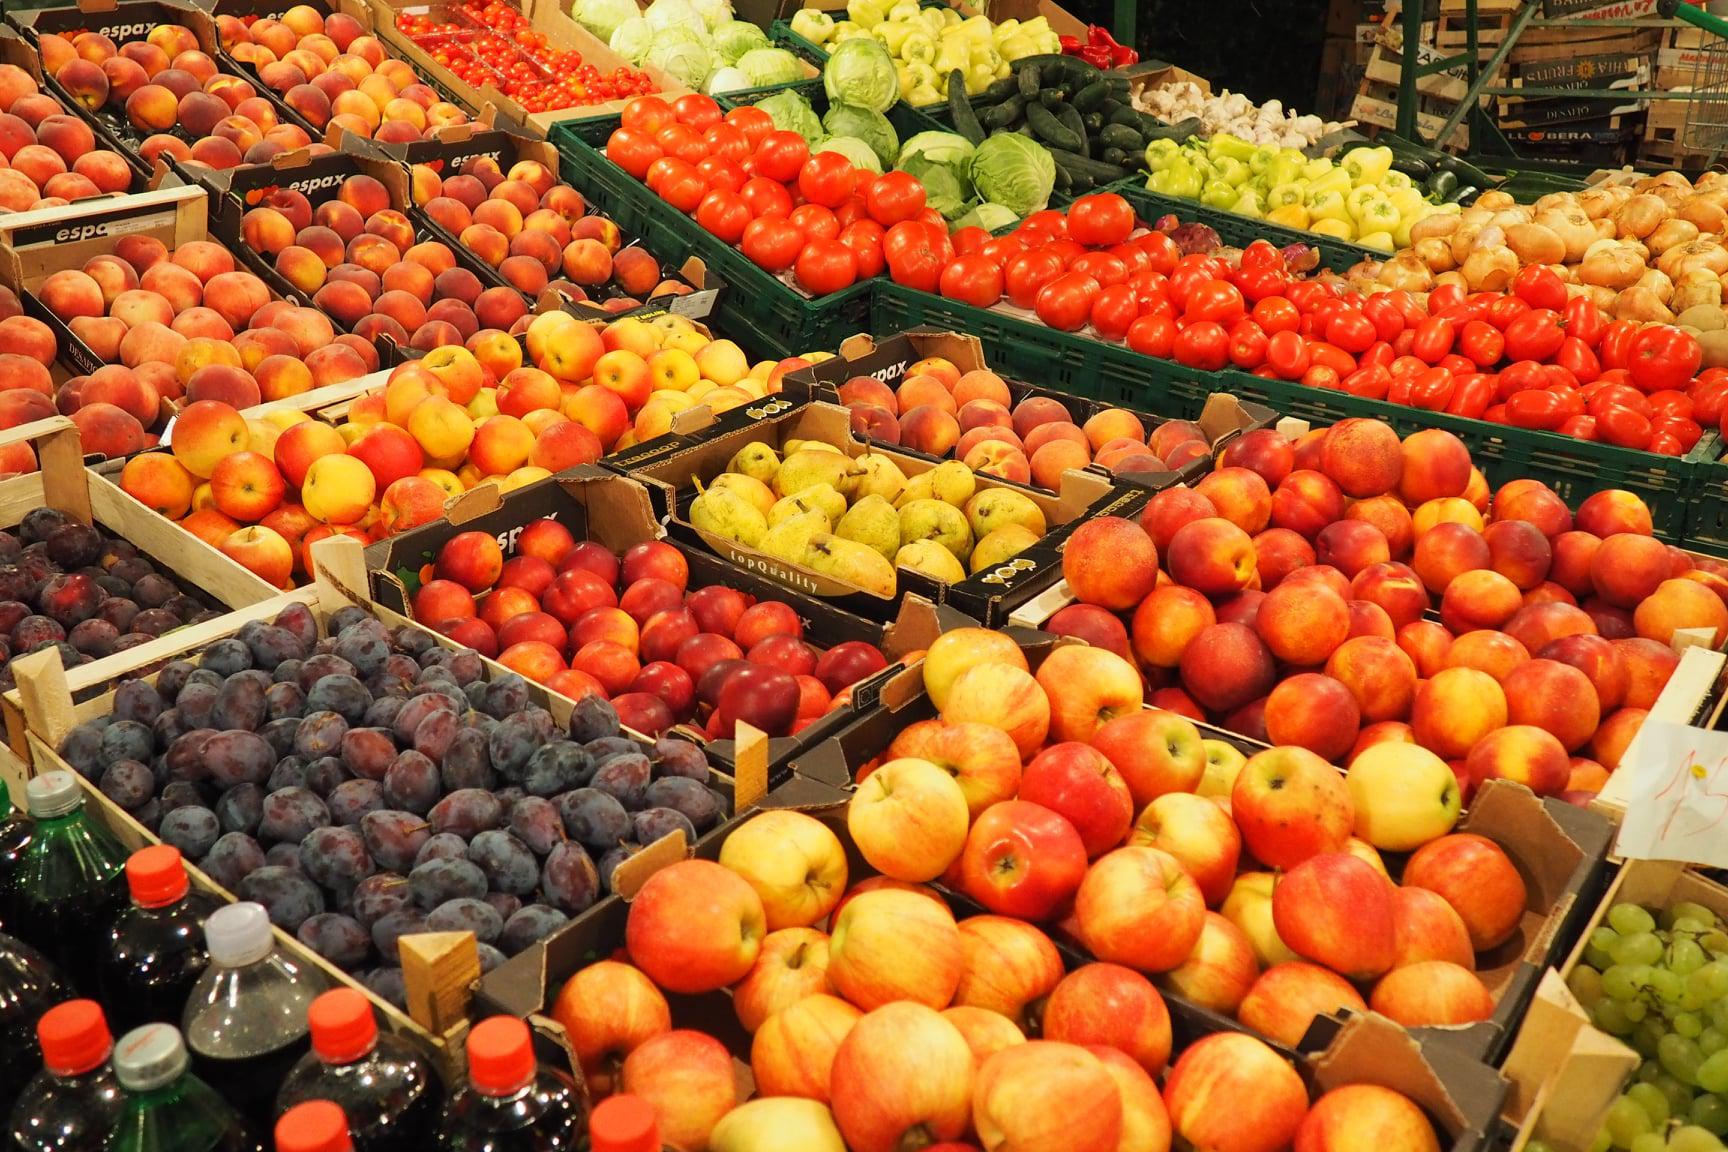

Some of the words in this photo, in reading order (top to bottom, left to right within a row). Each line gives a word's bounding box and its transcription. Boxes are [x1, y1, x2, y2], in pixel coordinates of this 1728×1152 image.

[100, 22, 157, 41] espax
[288, 172, 347, 196] espax
[56, 223, 108, 241] espa
[730, 550, 818, 594] topQuality
